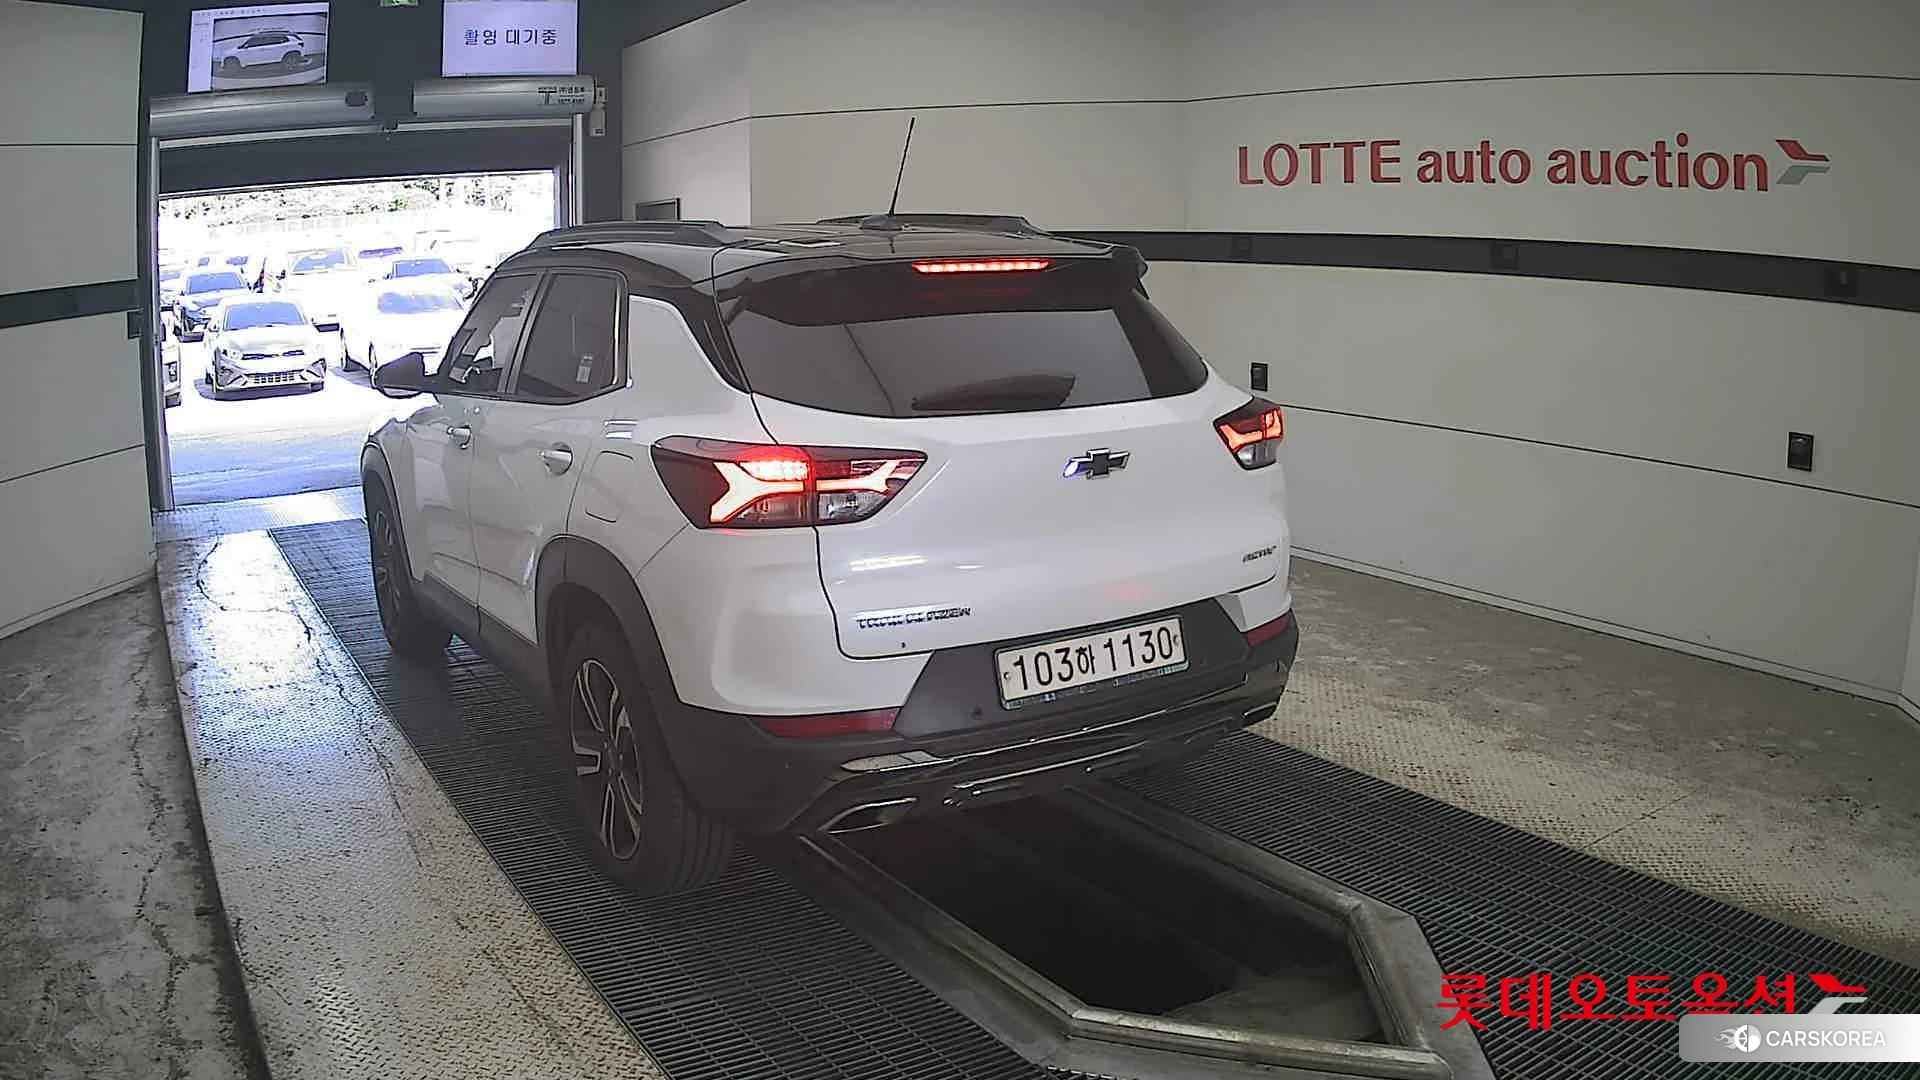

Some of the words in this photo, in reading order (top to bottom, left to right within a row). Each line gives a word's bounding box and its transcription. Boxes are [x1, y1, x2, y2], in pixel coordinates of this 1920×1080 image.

[505, 29, 557, 46] 대기중
[1238, 139, 1401, 186] LOTTE
[1416, 139, 1532, 185] auto
[1546, 132, 1768, 193] auction
[1013, 644, 1096, 691] 103하
[1103, 626, 1173, 672] 1130
